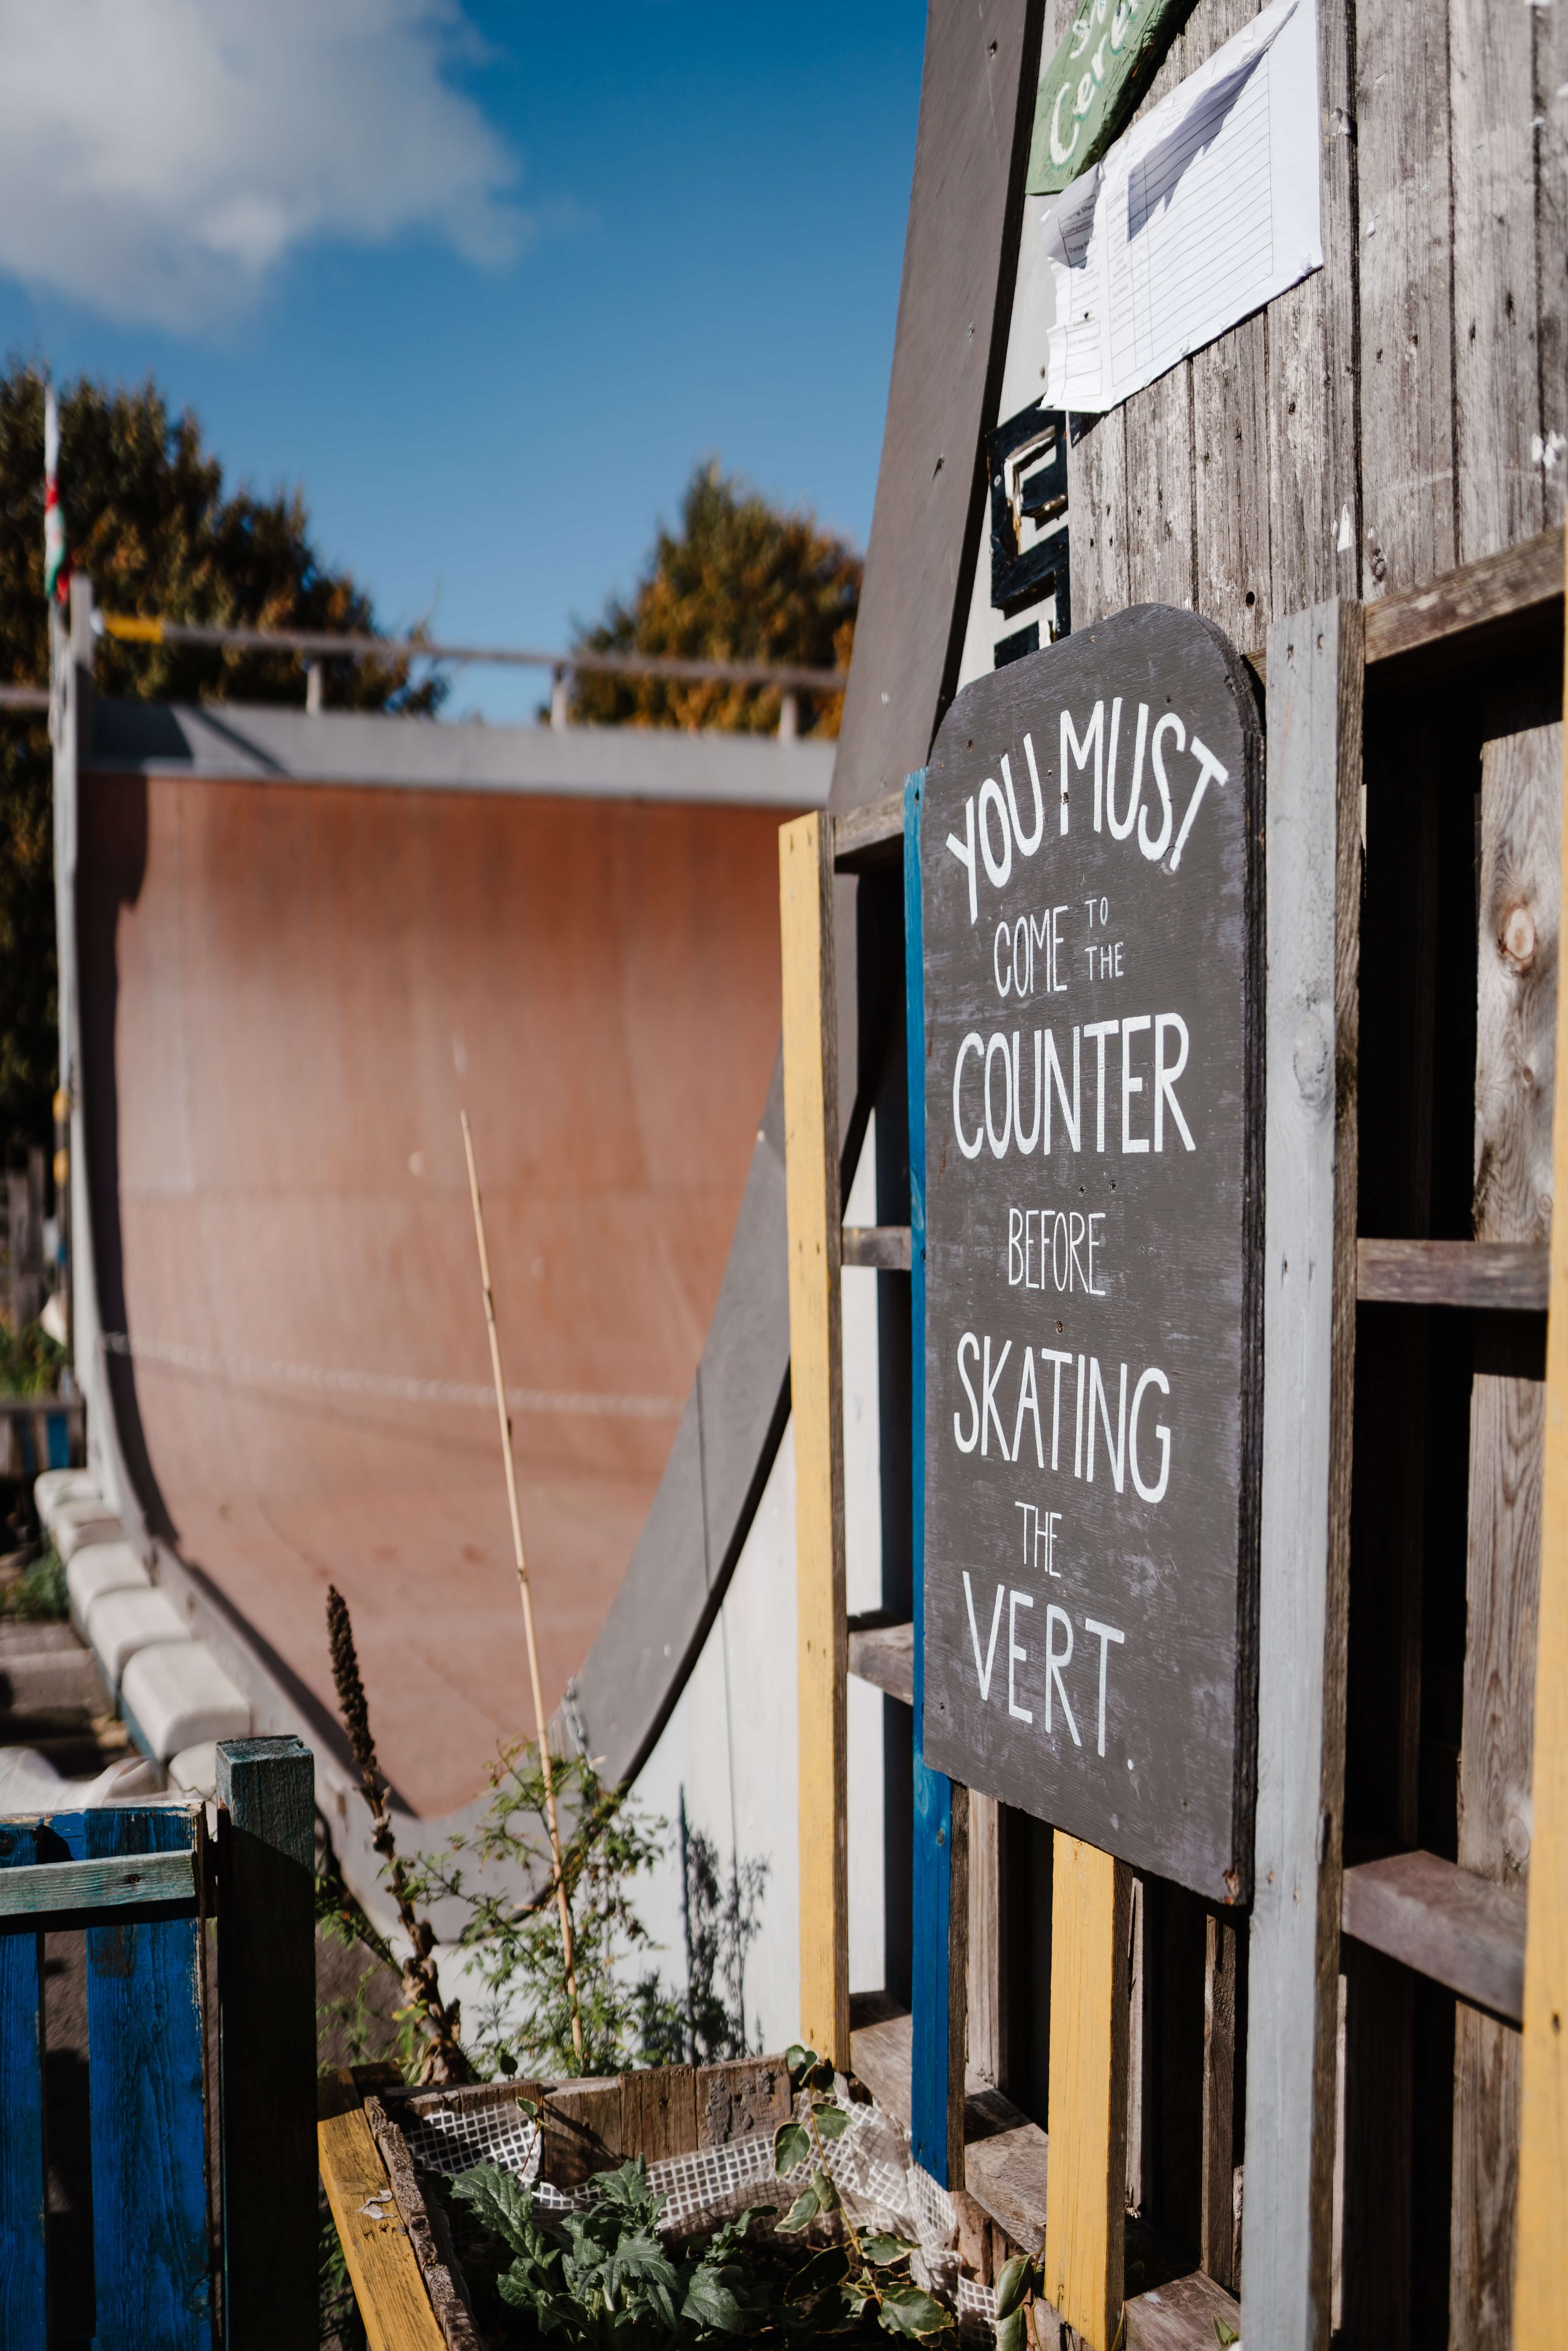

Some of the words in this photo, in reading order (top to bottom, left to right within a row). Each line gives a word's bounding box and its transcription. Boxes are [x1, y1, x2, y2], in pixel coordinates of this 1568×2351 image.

[946, 733, 1044, 925] YOU
[1060, 698, 1229, 871] MUST
[994, 906, 1068, 997] COME
[1085, 897, 1108, 927] TO
[1084, 942, 1123, 980] THE
[953, 1013, 1195, 1159] COUNTER
[1009, 1208, 1106, 1295] BEFORE
[954, 1332, 1170, 1503] SKATING
[1015, 1502, 1062, 1578] THE
